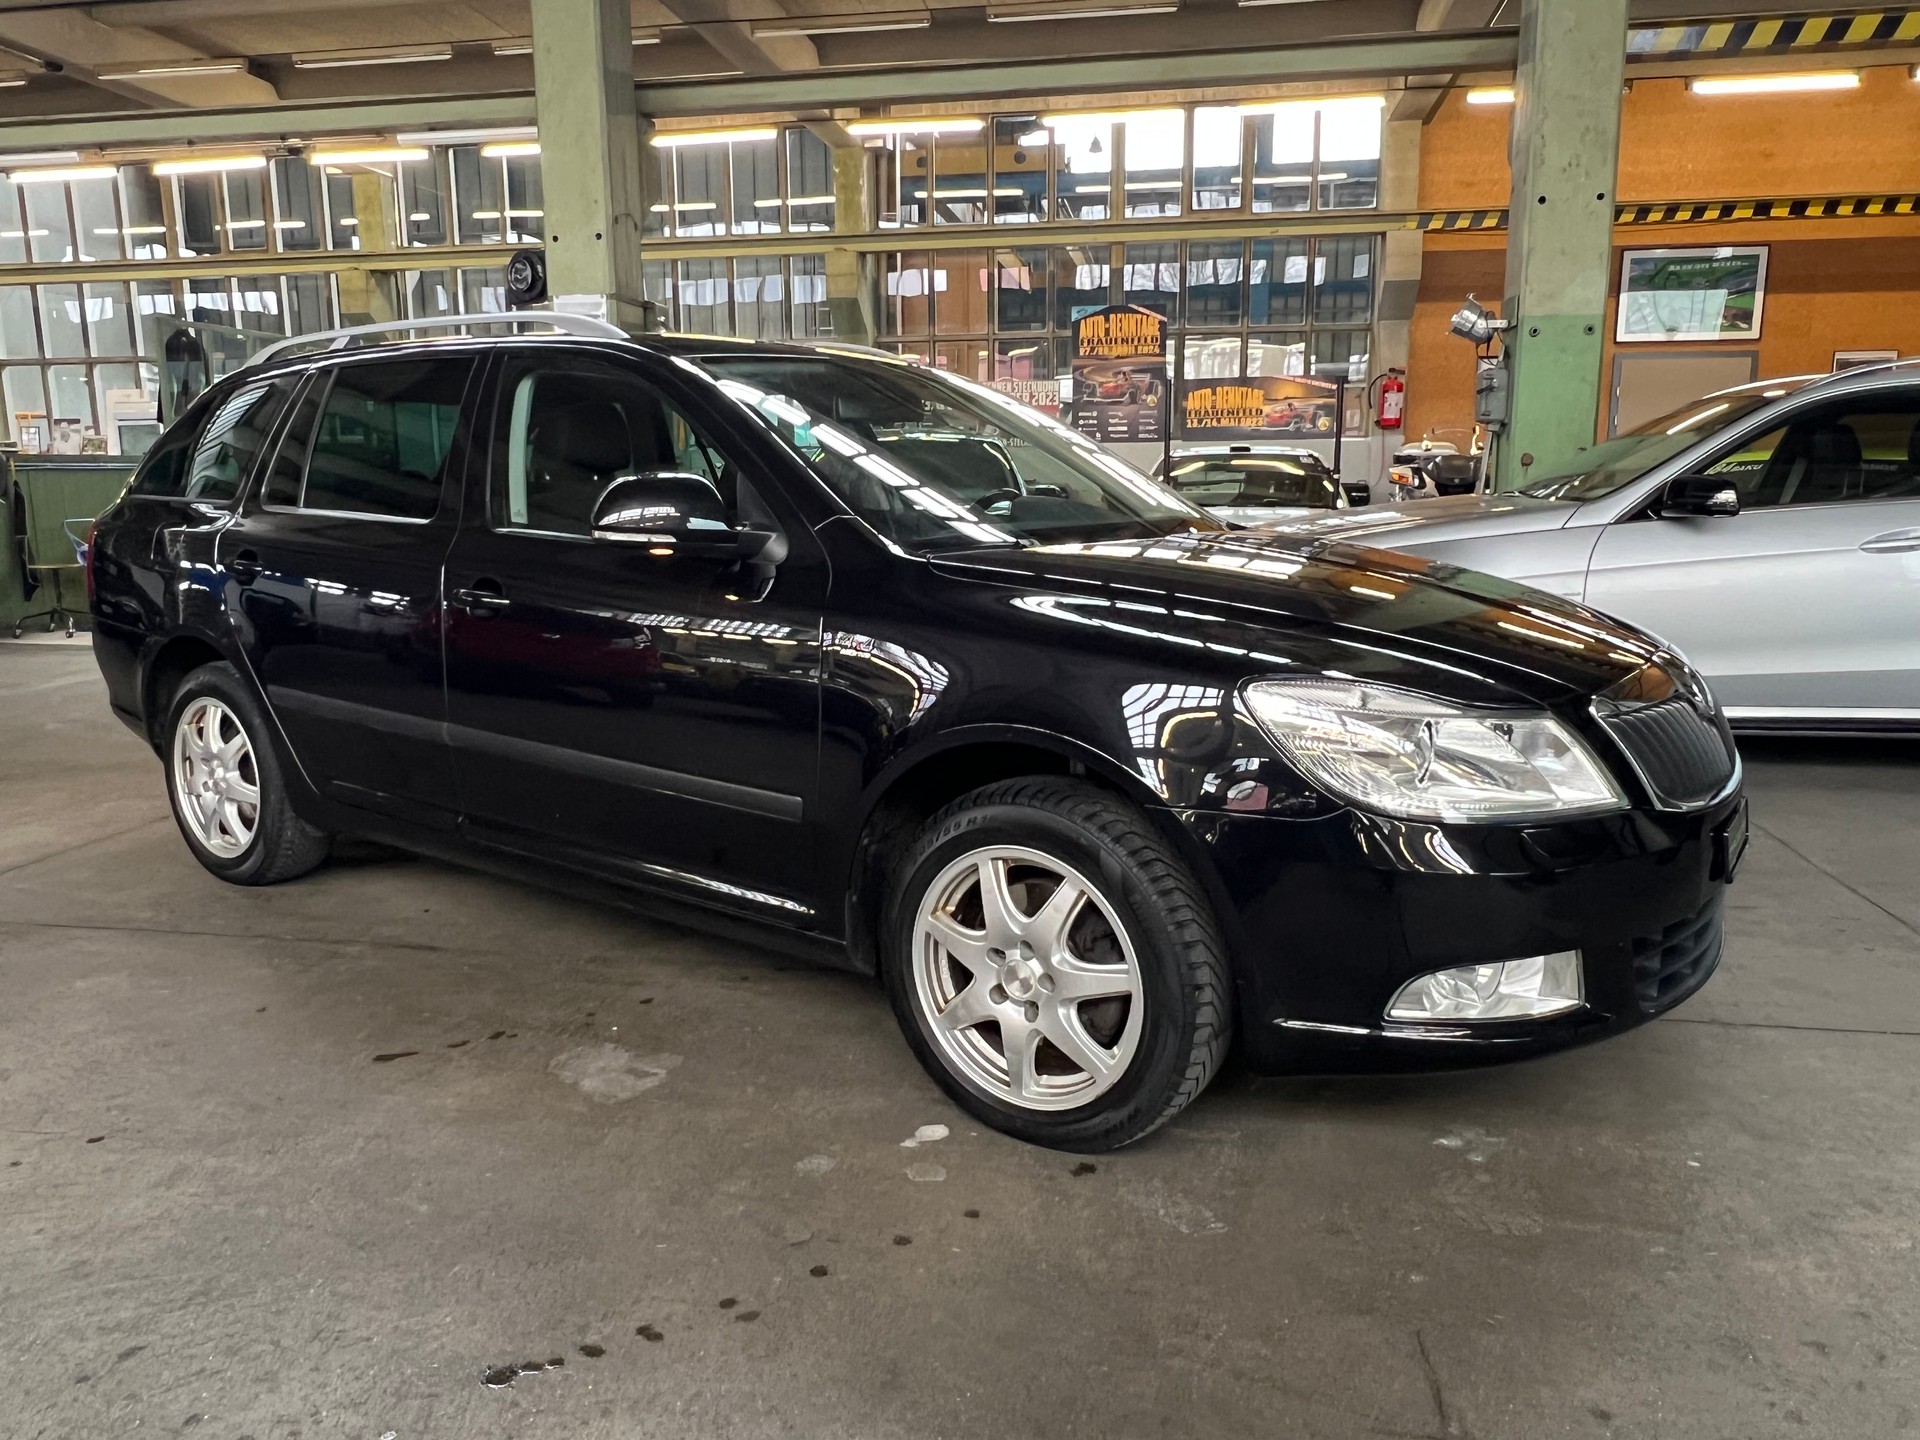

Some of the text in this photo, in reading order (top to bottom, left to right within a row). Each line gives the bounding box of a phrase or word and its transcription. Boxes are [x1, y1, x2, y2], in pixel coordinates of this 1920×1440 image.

[1080, 313, 1160, 337] AUTO-RENNTAGE
[1080, 336, 1160, 347] FRAUENFELD
[1031, 392, 1059, 406] 2023
[1187, 386, 1264, 410] AUTO-RENNTAGE
[1187, 408, 1263, 418] FRAUENFELD
